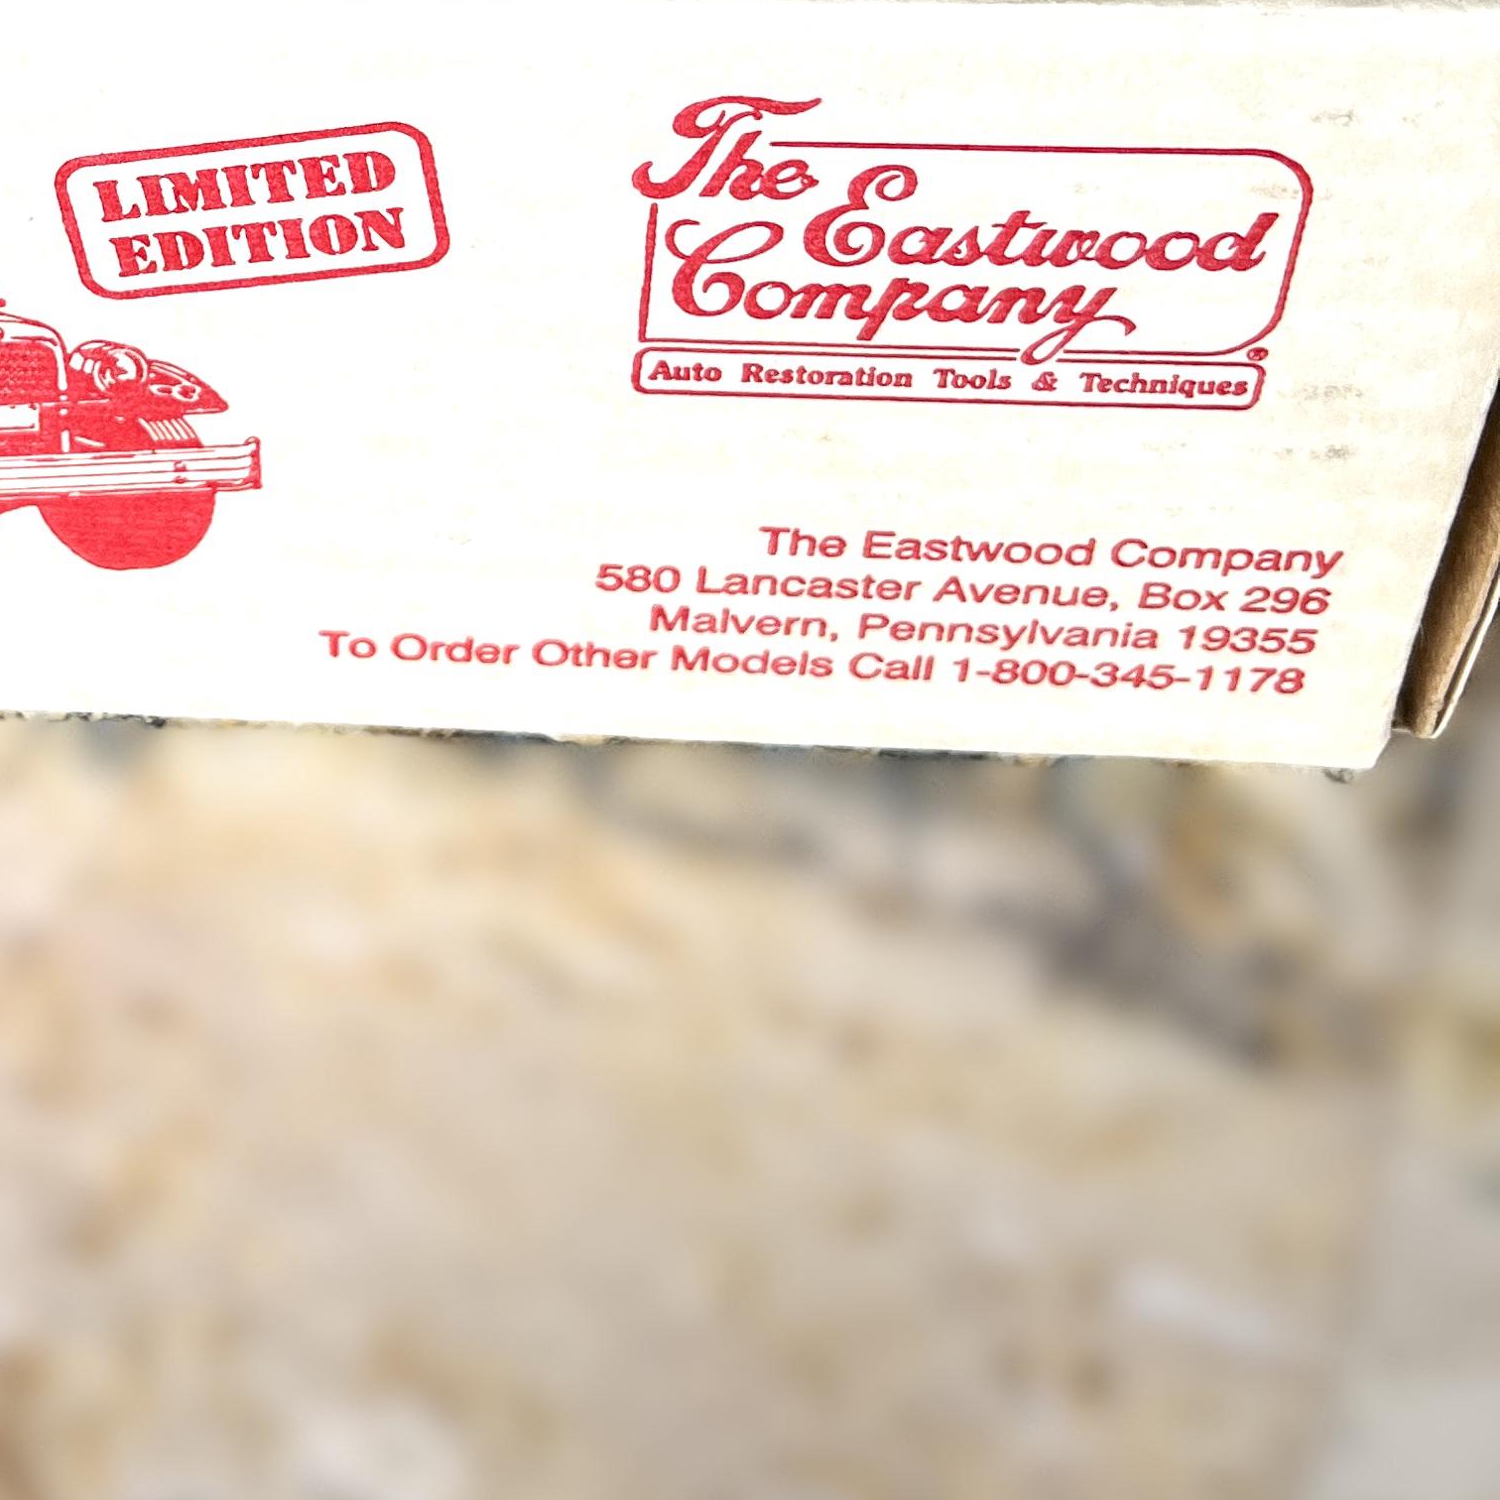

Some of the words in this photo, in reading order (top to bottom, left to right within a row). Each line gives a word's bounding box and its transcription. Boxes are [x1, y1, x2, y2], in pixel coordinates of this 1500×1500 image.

[631, 96, 822, 201] The
[93, 151, 396, 223] LIMITED
[802, 165, 1278, 271] Eastwood
[109, 207, 405, 278] EDITION
[664, 219, 1136, 364] Company
[649, 360, 722, 382] Auto
[742, 363, 912, 388] Restoration
[935, 368, 1010, 390] Tools
[1032, 372, 1056, 391] &
[1081, 373, 1247, 398] Techniques
[761, 527, 846, 557] The
[863, 532, 1095, 566] Eastwood
[1111, 538, 1344, 580] Company
[596, 564, 681, 593] 580
[697, 567, 918, 600] Lancaster
[934, 577, 1117, 611] Avenue,
[1139, 583, 1224, 611] Box
[1242, 587, 1331, 615] 296
[320, 631, 377, 658] To
[391, 634, 518, 664] Order
[532, 640, 655, 669] Other
[672, 646, 833, 677] Models
[849, 654, 933, 680] Call
[953, 656, 1308, 694] 1-800-345-1178
[650, 605, 836, 641] Malvern,
[858, 613, 1160, 651] Pennsylvania
[1184, 627, 1316, 654] 19355
